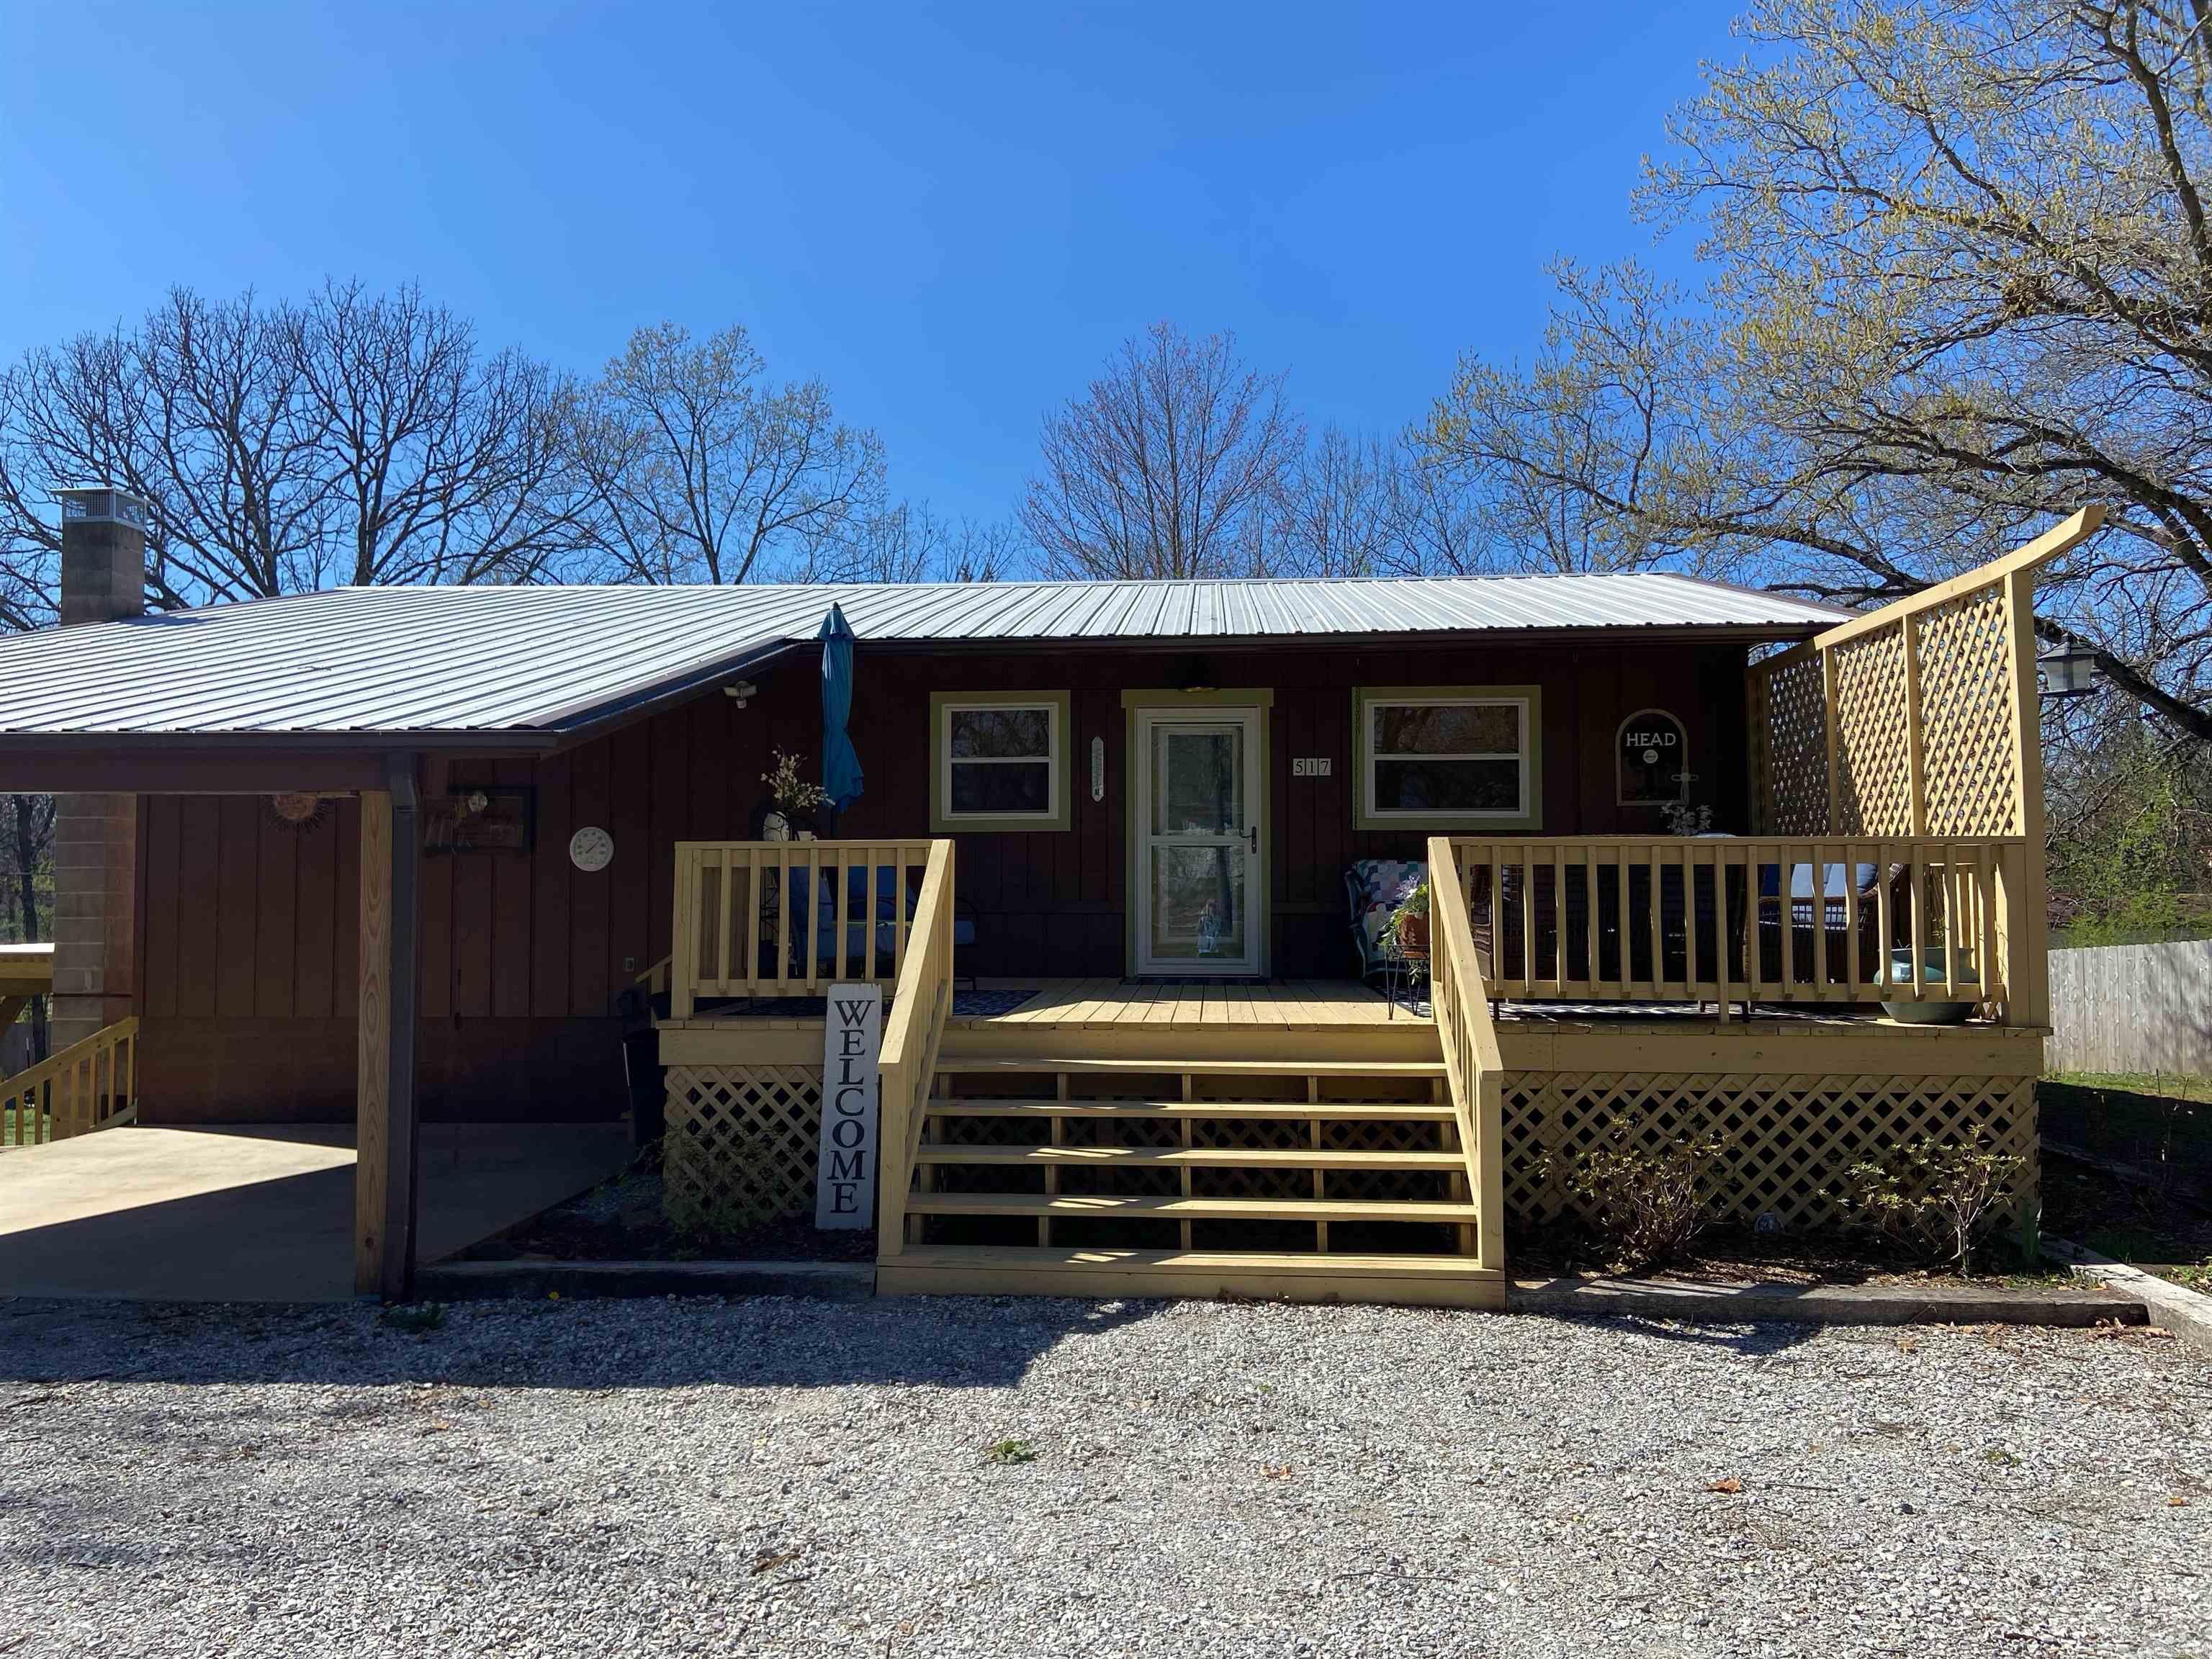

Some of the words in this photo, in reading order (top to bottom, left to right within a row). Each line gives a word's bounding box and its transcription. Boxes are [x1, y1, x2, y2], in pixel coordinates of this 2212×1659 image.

[1626, 733, 1676, 746] HEAD
[1295, 760, 1329, 773] 517
[827, 1000, 876, 1214] WELCOME
